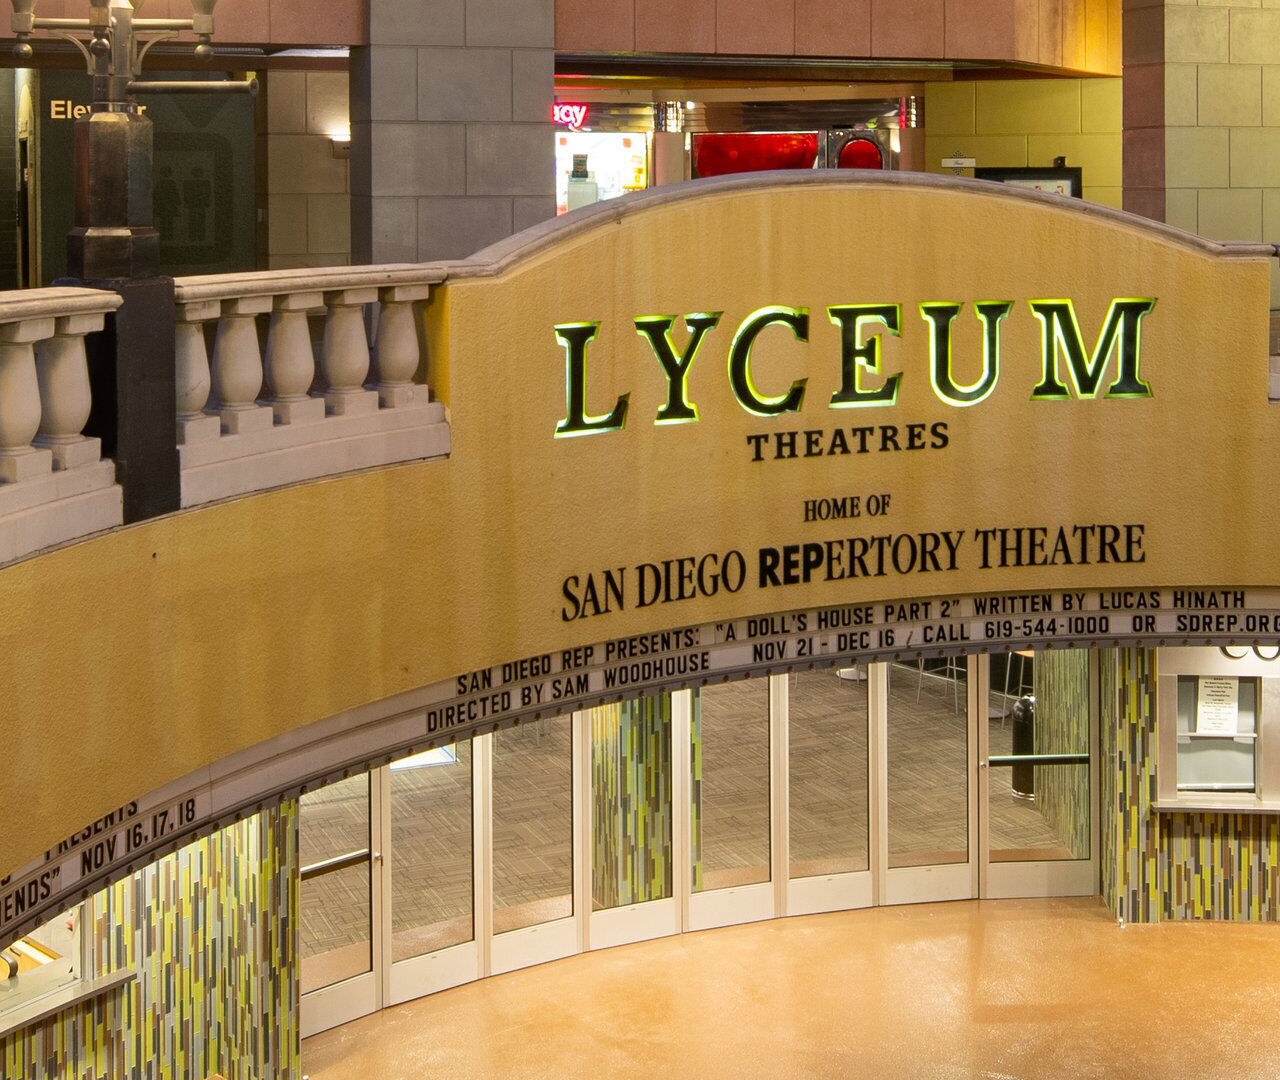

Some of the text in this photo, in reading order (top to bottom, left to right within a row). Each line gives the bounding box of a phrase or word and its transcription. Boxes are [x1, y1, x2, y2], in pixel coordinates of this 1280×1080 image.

[554, 297, 1158, 440] LYCEUM
[746, 422, 950, 462] THEATRES
[803, 493, 892, 522] HOME OF
[561, 523, 1147, 623] SAN DIEGO REPERTORY THEATRE
[427, 691, 512, 733] DIRECTED
[521, 683, 544, 707] BY
[551, 674, 590, 699] SAM
[603, 651, 711, 689] WOODHOUSE
[752, 640, 787, 663] NOV
[796, 639, 814, 657] 21
[837, 631, 871, 651] DEC
[878, 629, 896, 648] 16
[923, 623, 971, 643] CALL
[983, 616, 1110, 639] 619-544-1000
[1131, 614, 1157, 634] OR
[456, 590, 1246, 696] SAN DIEGO REP PRESENTS: "A DOLL'S HOUSE PART 2" WRITTEN BY LUCAS HINATH
[81, 834, 117, 877] NOV
